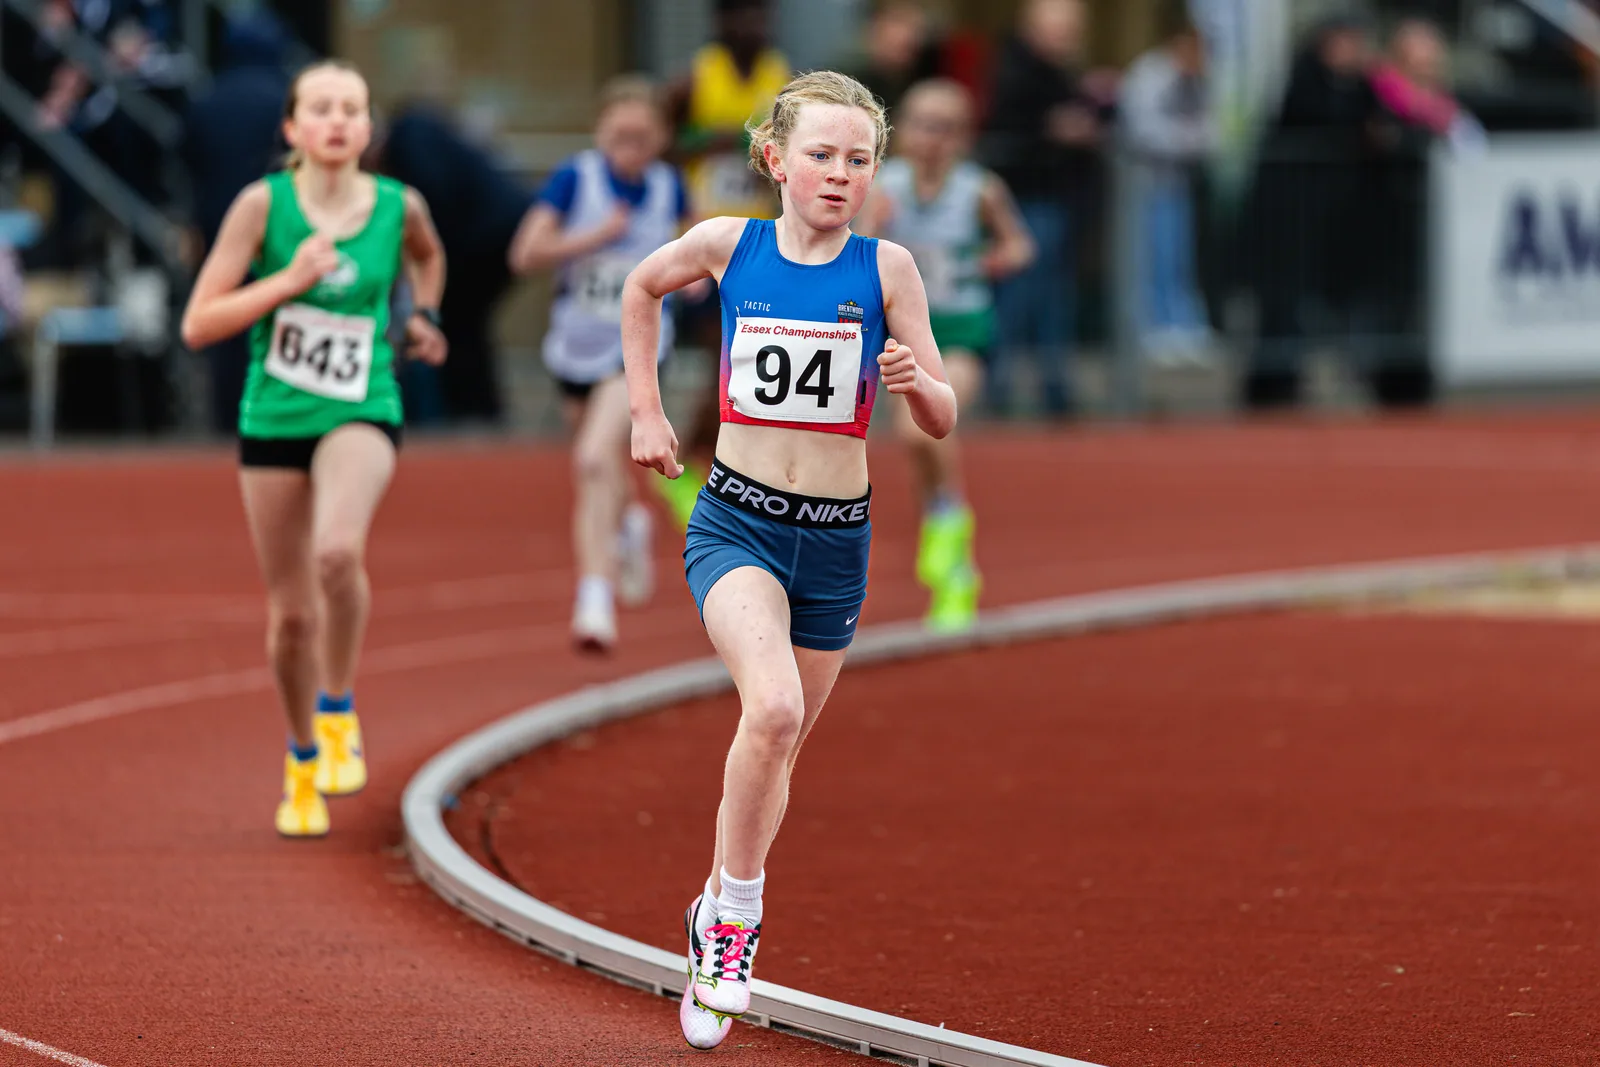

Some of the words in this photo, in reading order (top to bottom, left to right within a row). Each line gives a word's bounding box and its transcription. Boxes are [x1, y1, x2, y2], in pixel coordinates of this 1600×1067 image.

[744, 301, 771, 312] TACTIC
[838, 304, 863, 315] BRENTWOOD
[741, 324, 771, 335] Essex
[773, 326, 857, 341] Championships
[279, 324, 360, 383] 643
[755, 345, 834, 407] 94
[719, 476, 789, 515] PRO
[797, 501, 868, 522] NIKE
